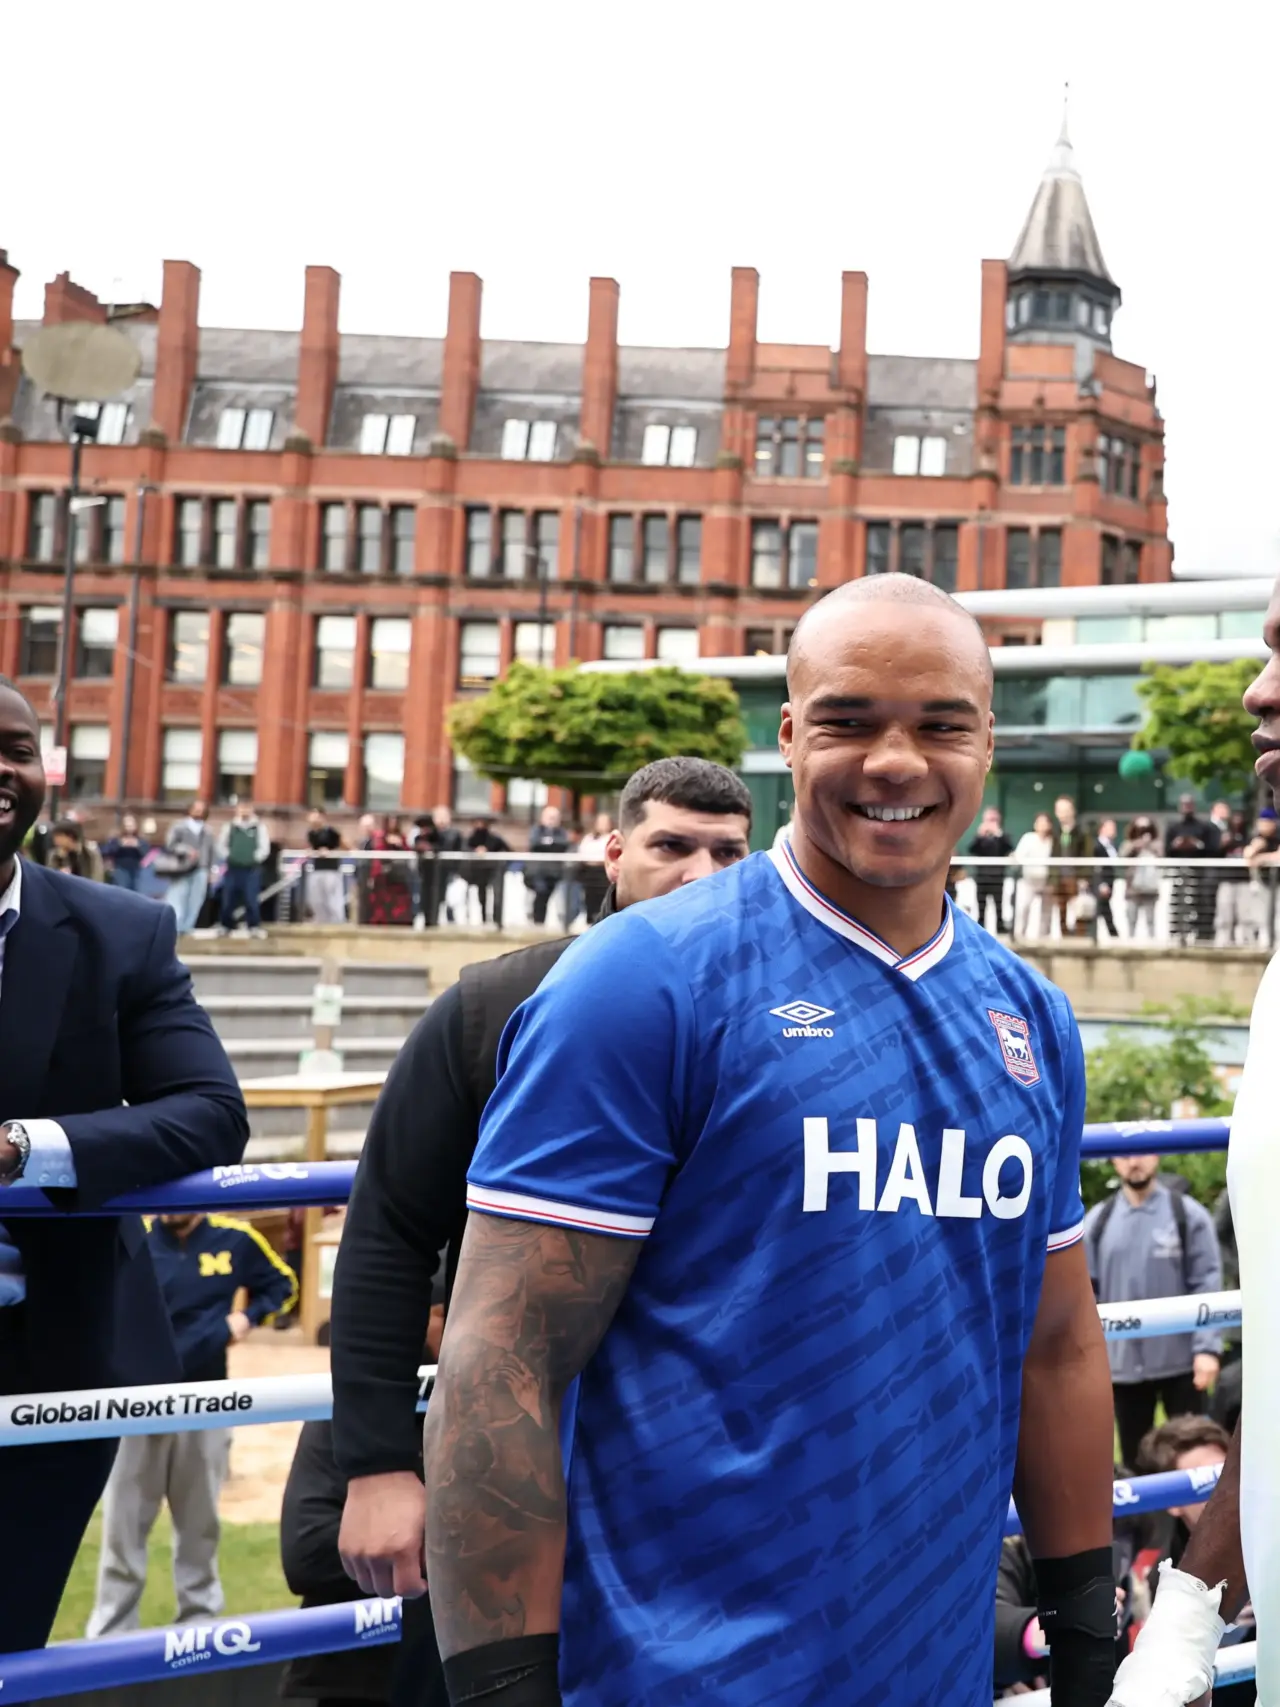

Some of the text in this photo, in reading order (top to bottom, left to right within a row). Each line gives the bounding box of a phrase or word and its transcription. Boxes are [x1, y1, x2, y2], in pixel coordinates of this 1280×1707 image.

[782, 1025, 834, 1039] umbro
[803, 1117, 1034, 1220] HALO
[198, 1250, 233, 1277] M
[11, 1391, 253, 1426] Global Next Trade
[355, 1596, 402, 1634] Mr
[164, 1621, 262, 1664] MrQ
[171, 1650, 212, 1669] casino
